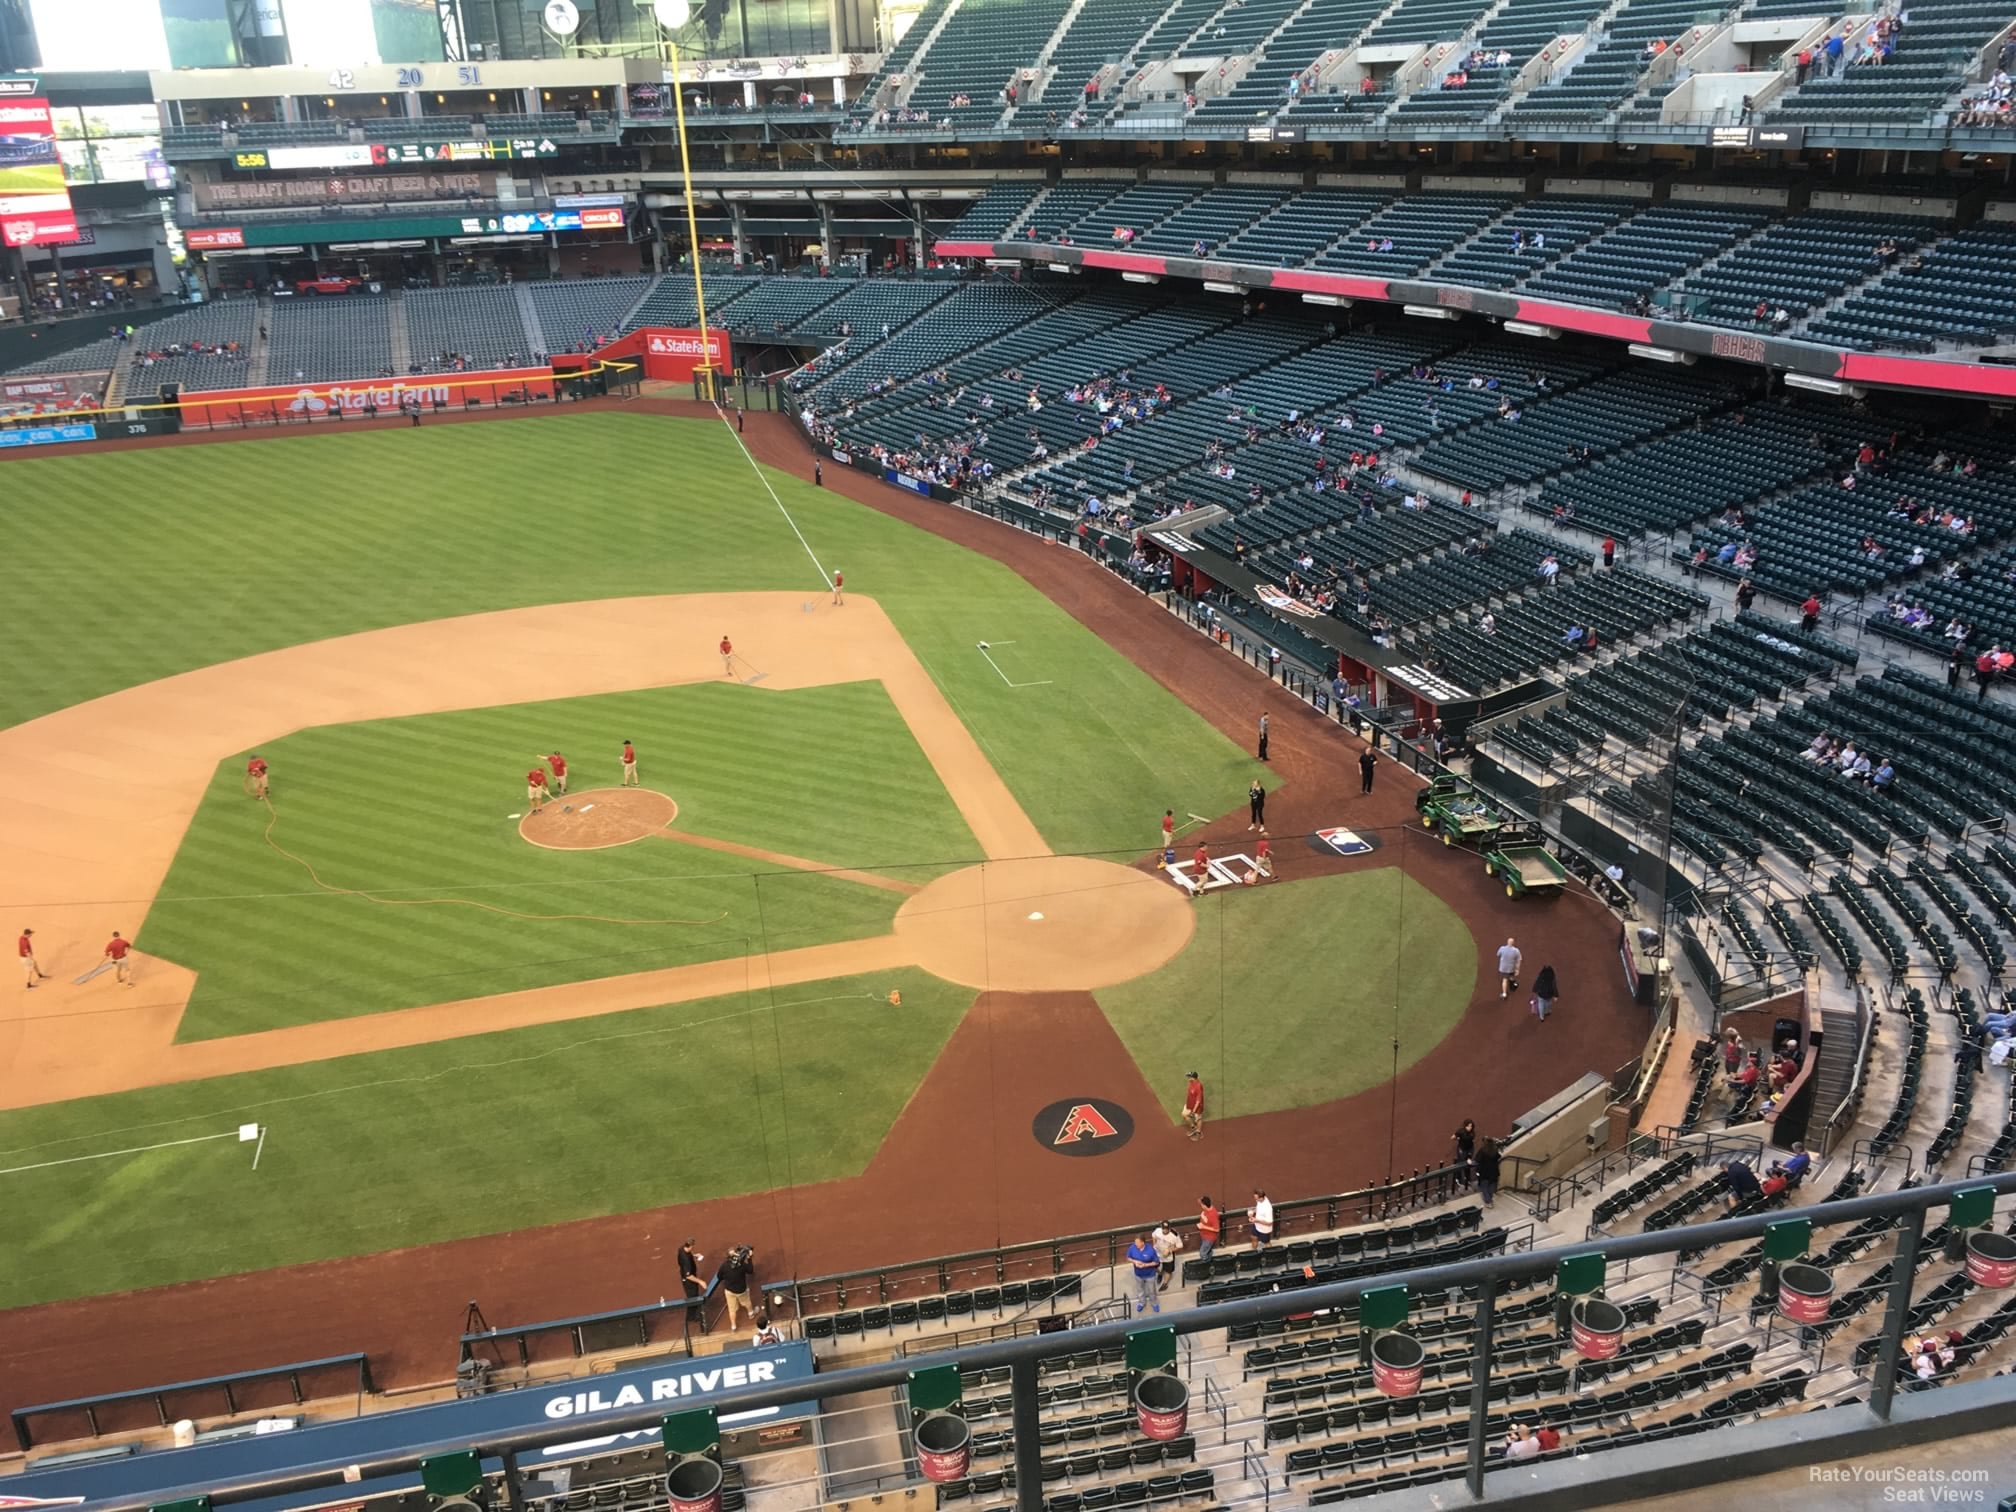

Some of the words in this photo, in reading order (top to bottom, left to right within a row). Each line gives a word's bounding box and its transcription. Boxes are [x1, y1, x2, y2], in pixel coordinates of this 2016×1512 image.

[329, 70, 355, 89] 42
[398, 68, 422, 87] 20
[458, 65, 482, 86] 51
[236, 154, 266, 167] 5:56
[370, 145, 387, 165] C
[388, 148, 398, 160] 6
[425, 146, 435, 159] 6
[209, 185, 237, 199] THE
[239, 182, 283, 198] DRAFT
[285, 180, 325, 196] ROOM
[349, 177, 389, 193] CRAFT
[392, 175, 426, 191] BEER
[666, 338, 692, 353] State
[692, 340, 717, 354] Fam
[329, 385, 391, 411] State
[393, 382, 449, 405] Farm
[62, 427, 87, 438] cox
[127, 424, 147, 435] 376
[544, 1384, 645, 1419] GILA
